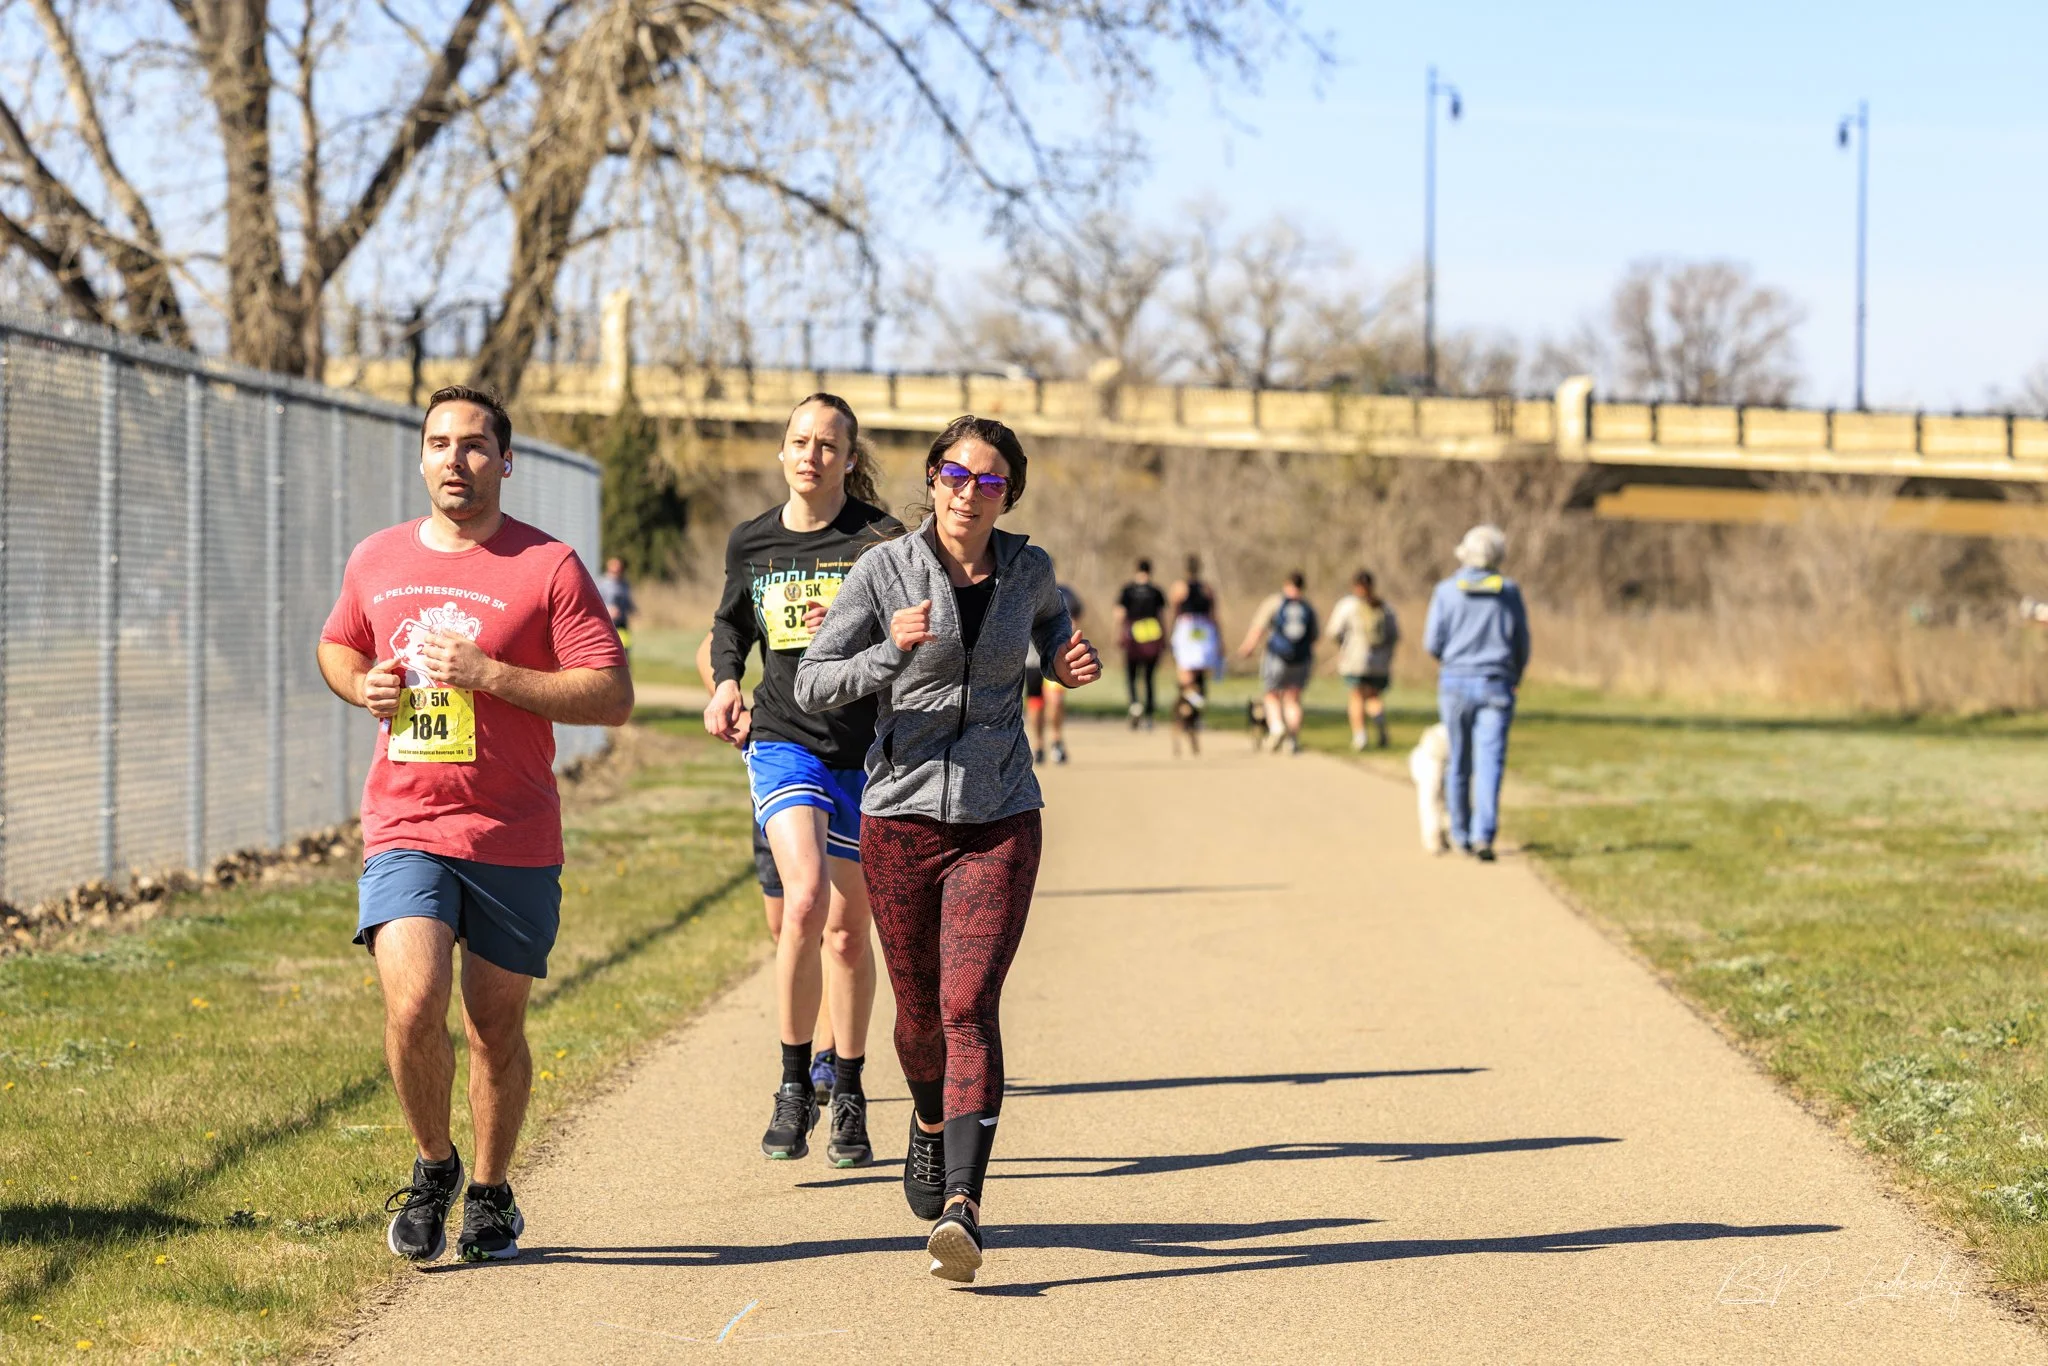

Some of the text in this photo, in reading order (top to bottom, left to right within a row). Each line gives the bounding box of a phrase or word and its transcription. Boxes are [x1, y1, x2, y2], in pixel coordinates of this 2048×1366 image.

[373, 584, 508, 612] EL PELÓN RESERVOIR 5K
[805, 583, 822, 597] 5K
[784, 605, 811, 629] 37
[431, 691, 450, 707] 5K
[409, 713, 449, 740] 184
